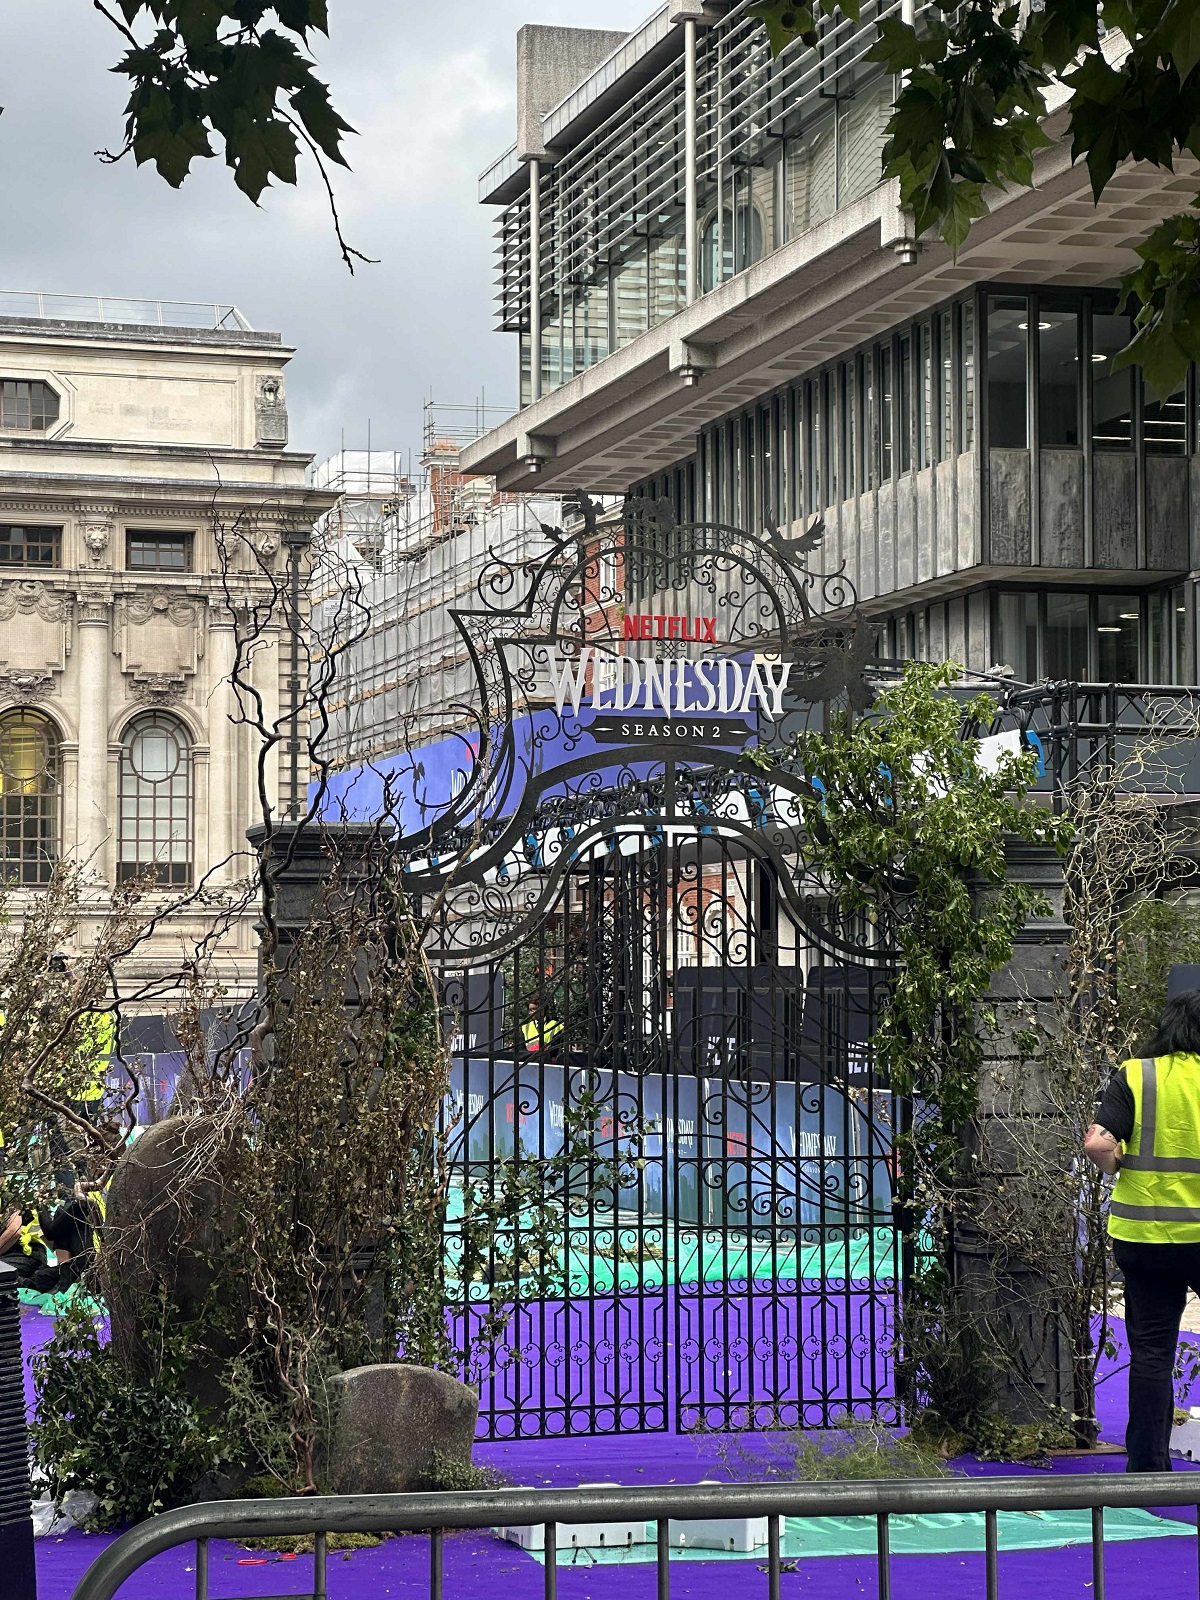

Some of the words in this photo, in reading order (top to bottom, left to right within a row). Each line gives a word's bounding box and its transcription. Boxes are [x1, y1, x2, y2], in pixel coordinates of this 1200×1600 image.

[624, 614, 718, 643] NETFLIX
[543, 646, 794, 722] WEDNESDAY
[621, 724, 705, 737] SEASON
[712, 726, 721, 738] 2
